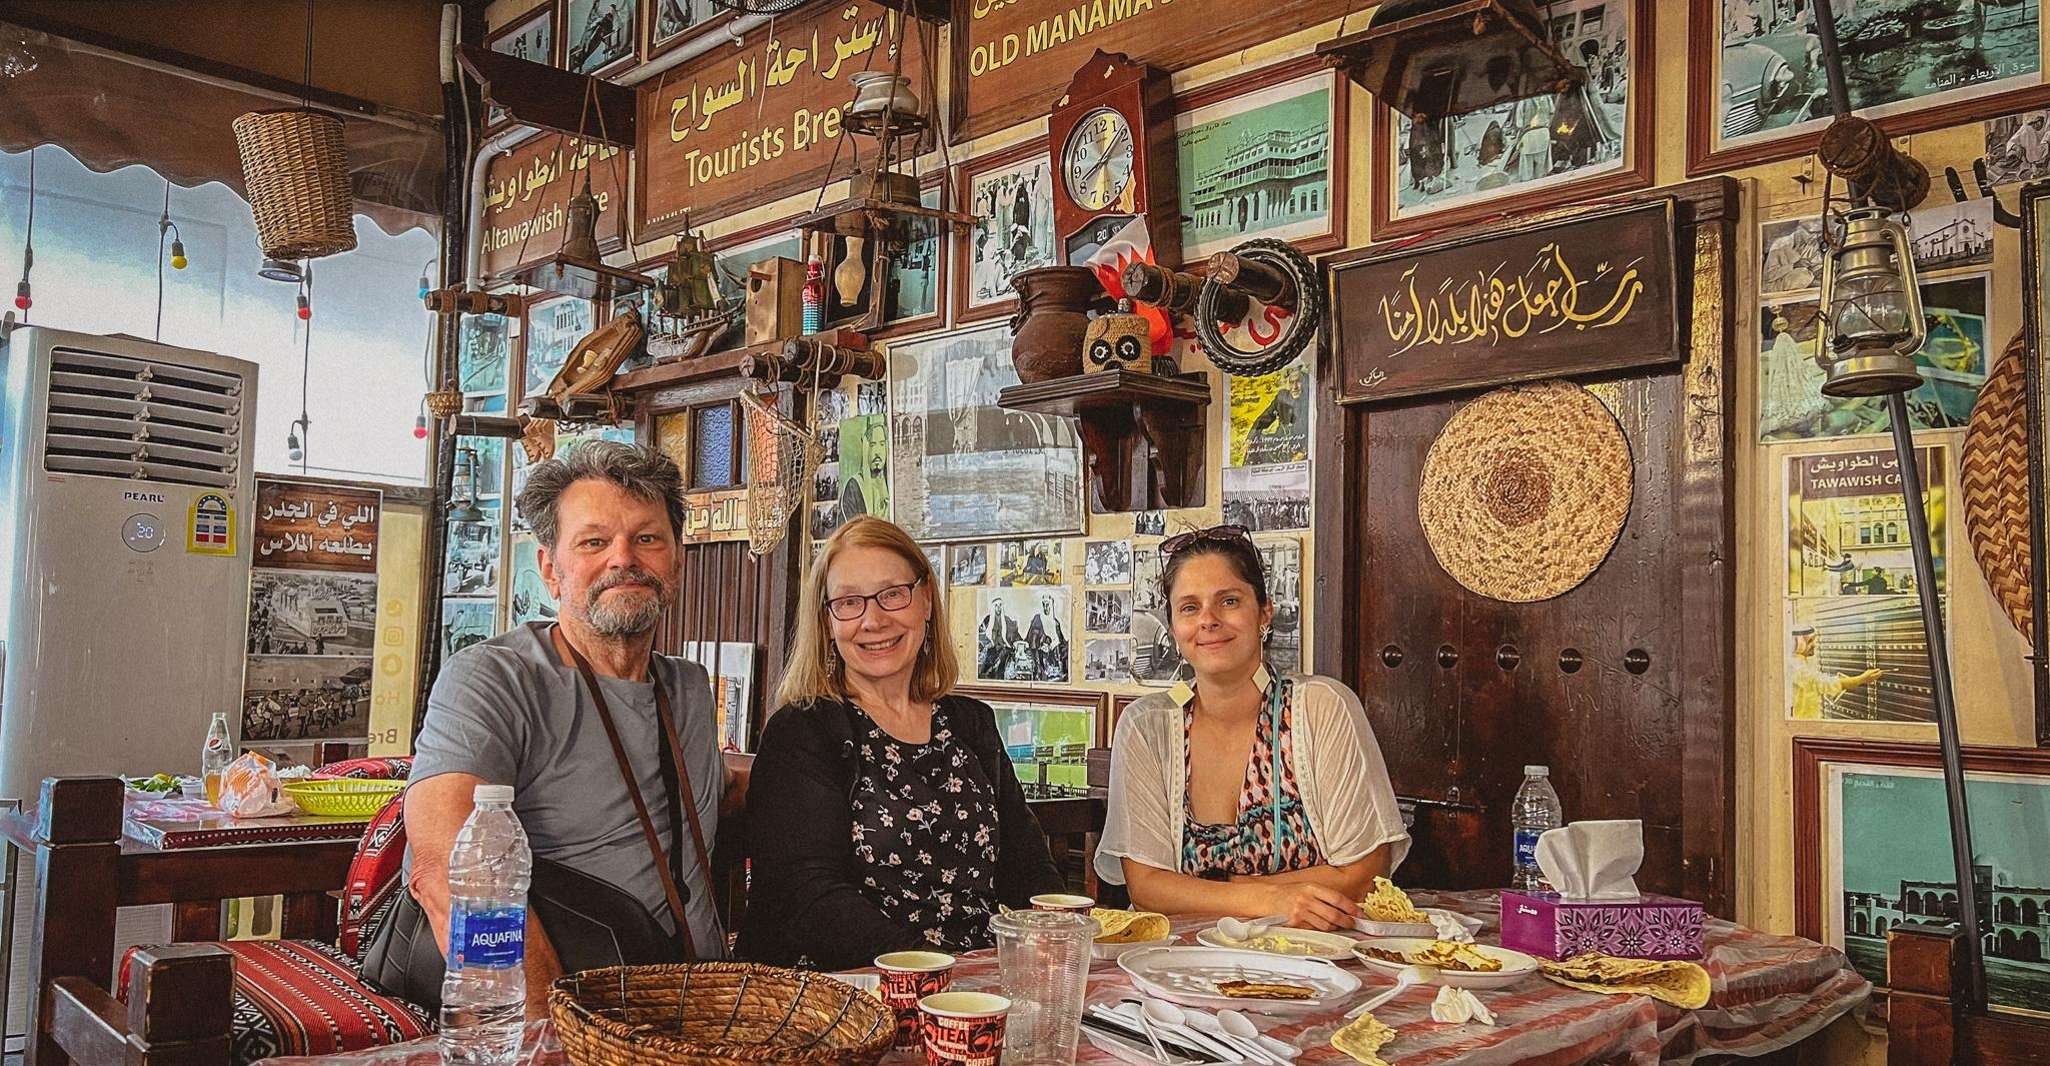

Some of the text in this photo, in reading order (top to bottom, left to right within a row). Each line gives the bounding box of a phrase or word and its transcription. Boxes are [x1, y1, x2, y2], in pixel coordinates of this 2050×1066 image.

[969, 33, 1020, 78] OLD
[670, 53, 756, 142] السواح
[1094, 119, 1107, 133] 12
[1112, 119, 1117, 132] 1
[1082, 132, 1093, 145] 11
[1120, 128, 1129, 142] 2
[685, 101, 853, 188] Tourists Bre
[1126, 144, 1133, 158] 3
[1075, 147, 1087, 162] 10
[1074, 165, 1082, 179] 9
[1123, 164, 1131, 176] 4
[1079, 181, 1087, 194] 8
[1114, 181, 1121, 194] 5
[1090, 190, 1097, 203] 7
[1102, 190, 1110, 203] 6
[481, 202, 563, 255] Altawawish
[1810, 455, 1879, 474] الطواويش
[1810, 473, 1902, 489] TAWAWISH CA
[124, 491, 164, 503] PEARL
[262, 499, 374, 530] اللي في الجدر
[318, 534, 373, 560] يطلعه
[471, 929, 523, 948] AQUAFINA
[938, 1016, 970, 1031] COFFEE
[938, 1028, 968, 1043] TEA
